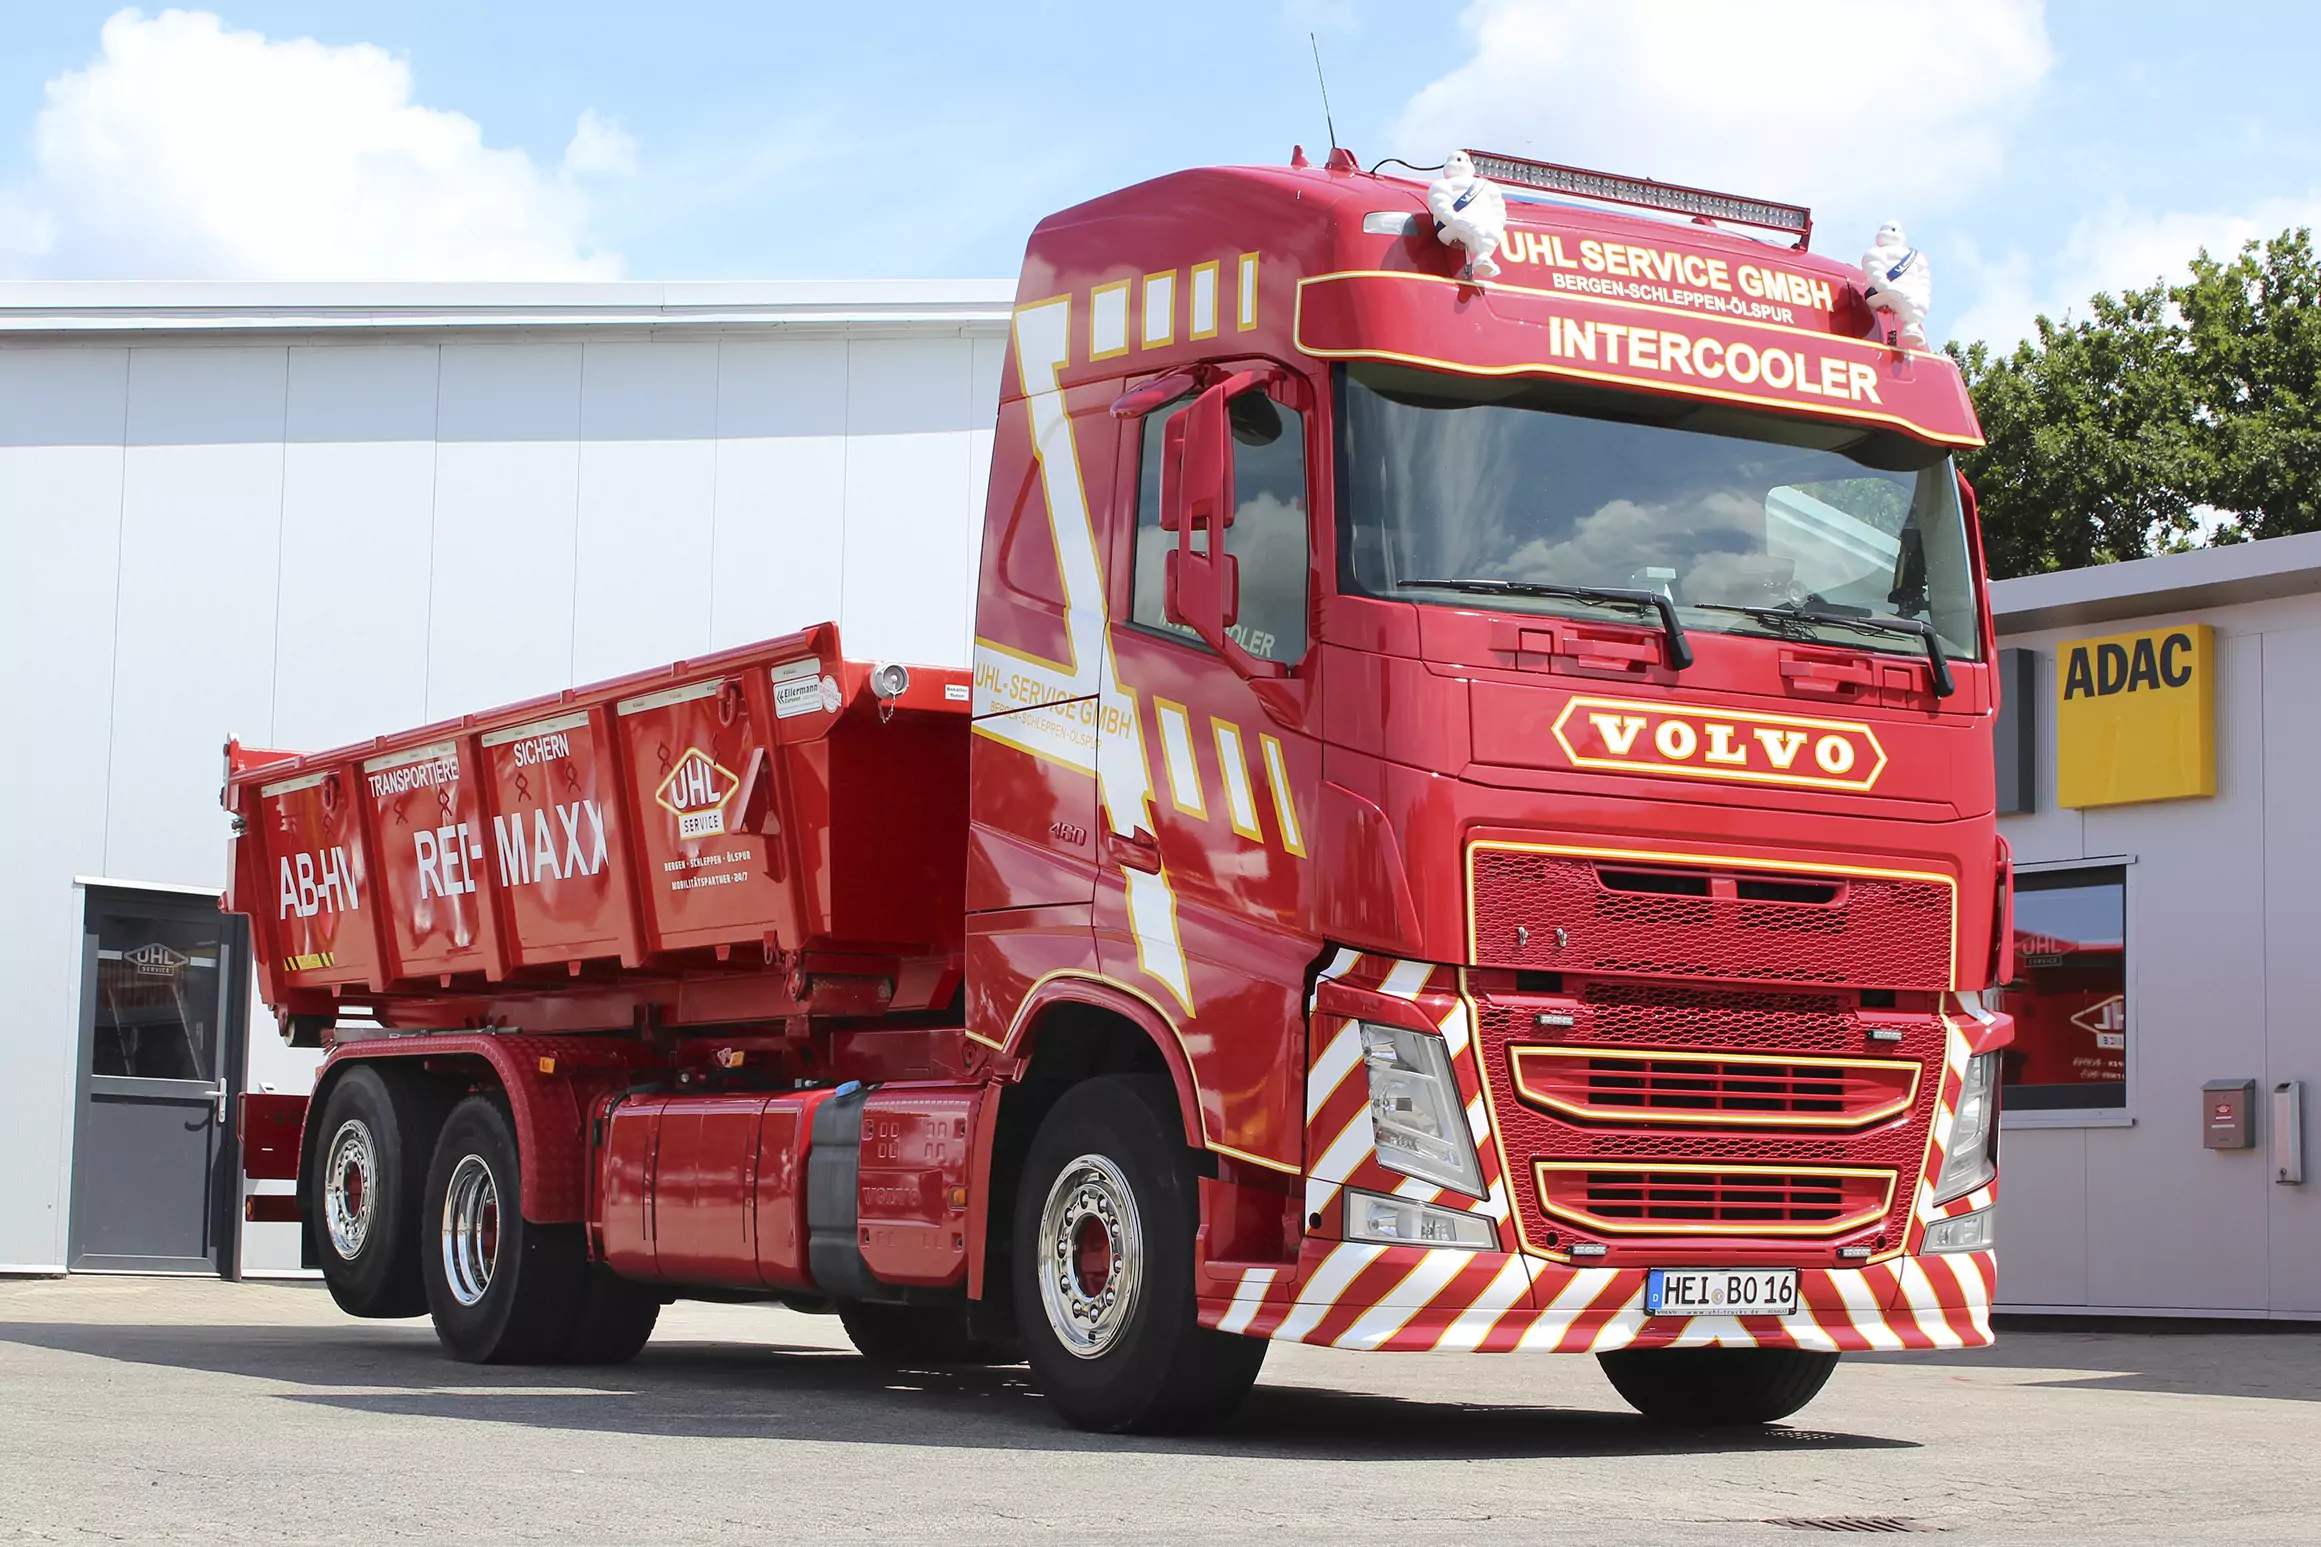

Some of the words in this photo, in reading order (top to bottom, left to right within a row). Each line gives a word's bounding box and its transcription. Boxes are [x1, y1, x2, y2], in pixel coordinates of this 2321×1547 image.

[1499, 230, 1578, 269] UHL
[1579, 238, 1732, 294] SERVICE
[1738, 264, 1834, 313] GMBH
[1552, 273, 1794, 324] BERGEN-SCHLEPPEN-ÖLSPUR
[1548, 316, 1884, 405] INTERCOOLER
[2063, 633, 2192, 700] ADAC
[1080, 699, 1133, 739] GMBH
[514, 733, 570, 767] SICHERN
[1589, 711, 1855, 774] VOLVO
[671, 757, 721, 809] UHL
[493, 799, 609, 887] MAXX
[684, 814, 719, 833] SERVICE
[664, 860, 686, 872] BERGEN
[690, 854, 722, 868] SCHLEPPEN
[136, 947, 175, 965] UHL
[141, 966, 170, 974] SERVICE
[1652, 1293, 1659, 1302] D
[1664, 1276, 1710, 1305] HEI
[1726, 1276, 1758, 1305] BO
[1764, 1275, 1793, 1304] 16
